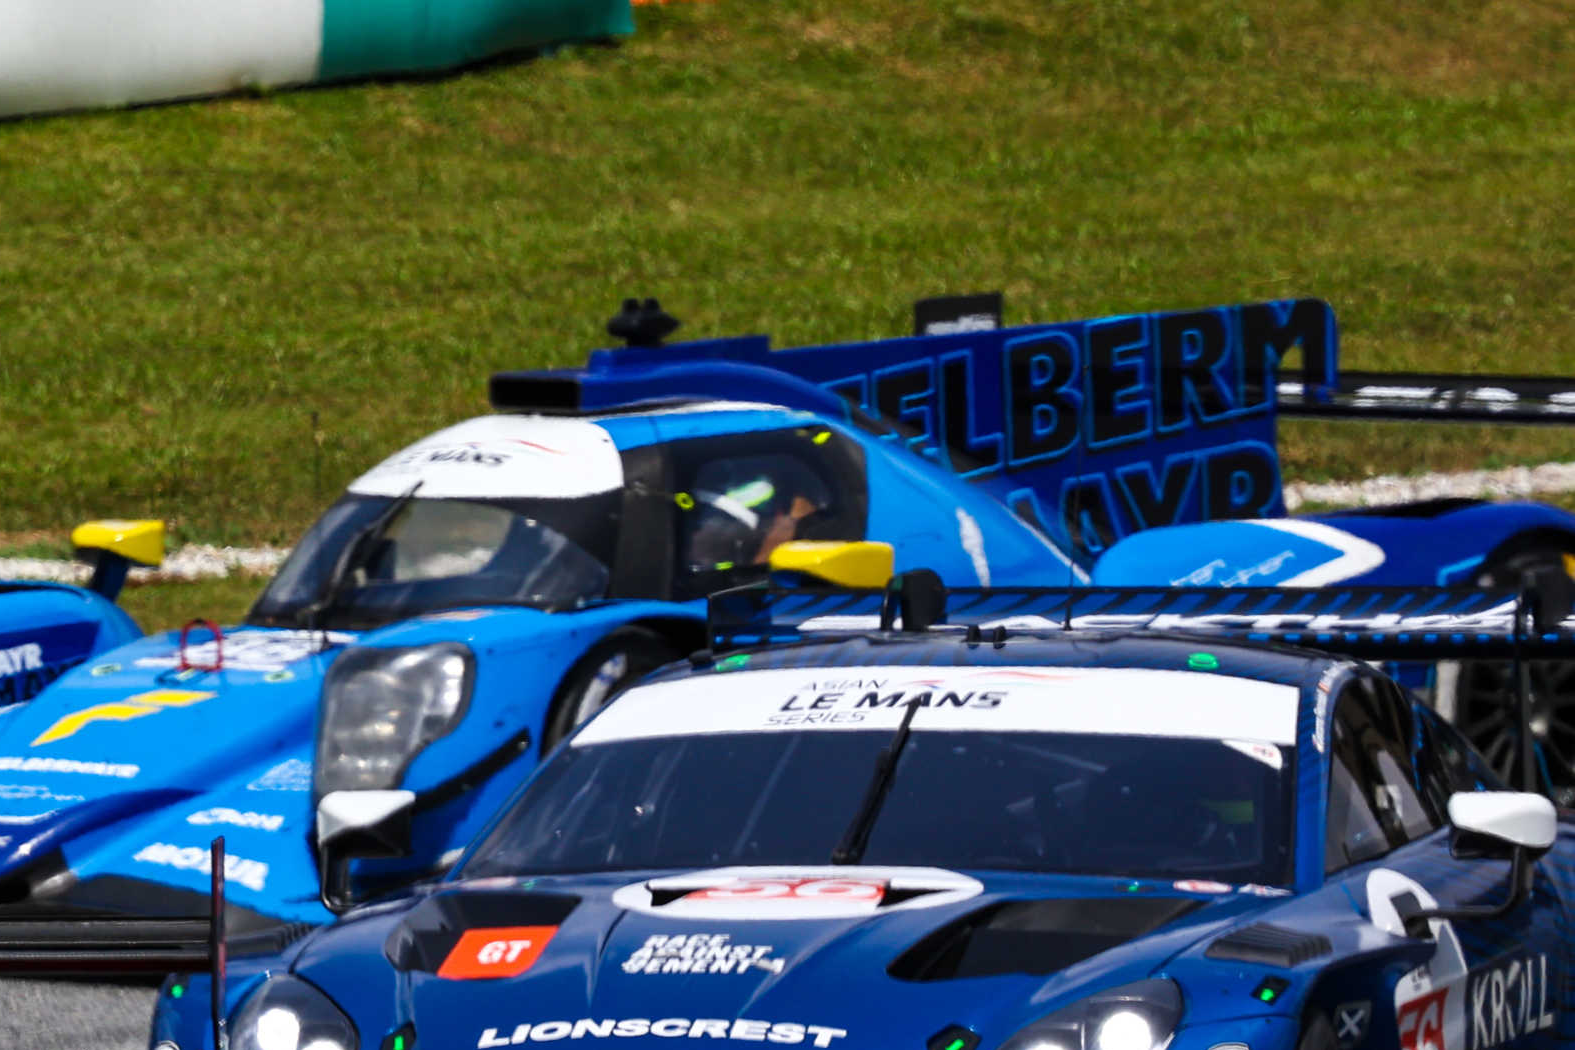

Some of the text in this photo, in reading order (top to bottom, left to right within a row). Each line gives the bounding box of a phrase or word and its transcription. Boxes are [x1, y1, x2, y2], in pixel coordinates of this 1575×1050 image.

[1007, 441, 1281, 556] AYR
[801, 679, 888, 692] ASIAN
[779, 691, 1009, 712] LE MANS
[763, 710, 869, 727] SERIES
[475, 940, 531, 965] GT
[477, 1018, 847, 1049] LIONSCREST
